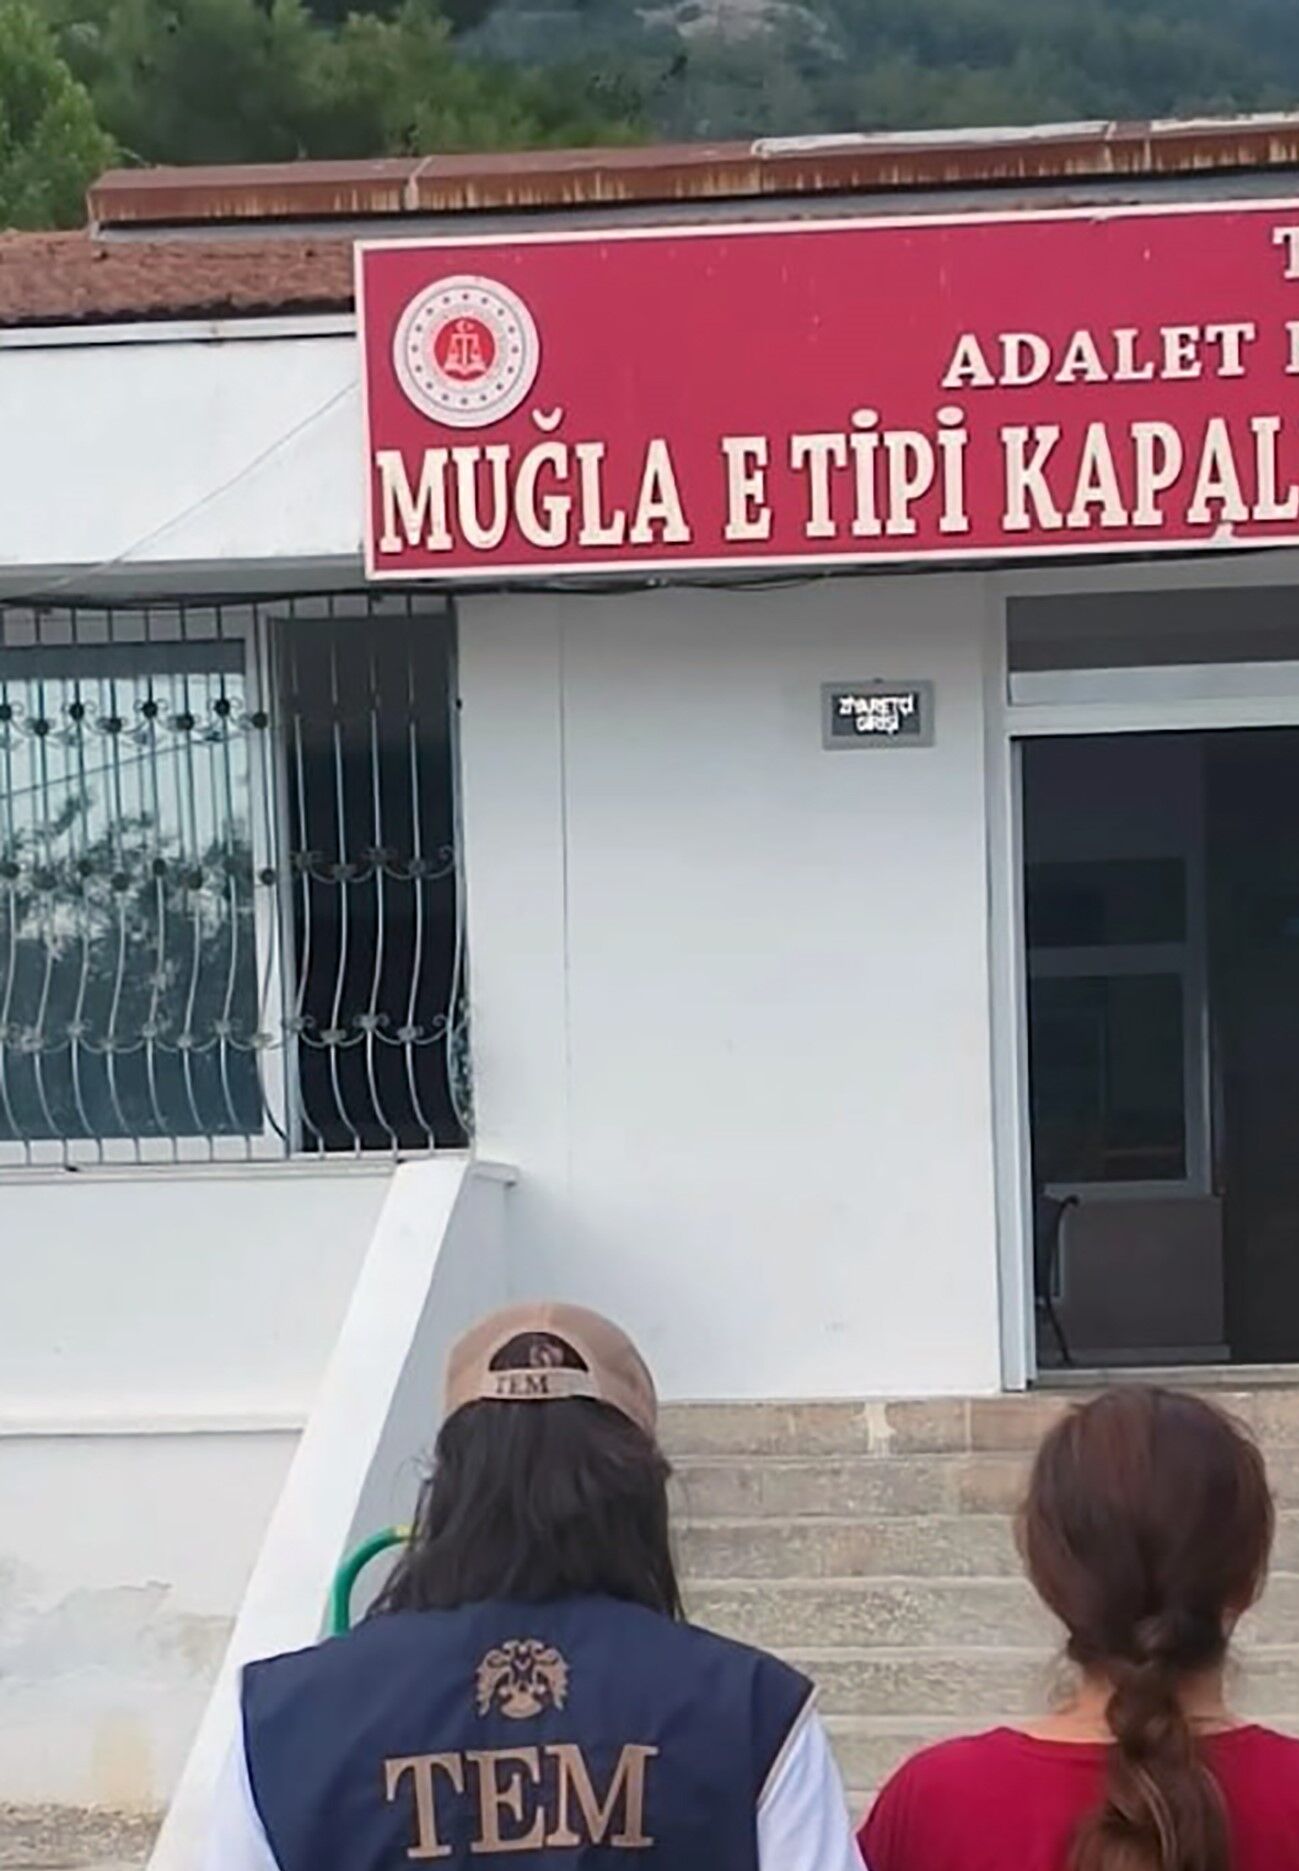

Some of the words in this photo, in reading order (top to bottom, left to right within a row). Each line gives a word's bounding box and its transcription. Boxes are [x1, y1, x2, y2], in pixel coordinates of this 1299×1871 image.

[941, 322, 1256, 388] ADALET
[376, 406, 691, 554] MUĞLA
[721, 435, 773, 541] E
[791, 405, 969, 538] TİPİ
[384, 1743, 659, 1859] TEM
